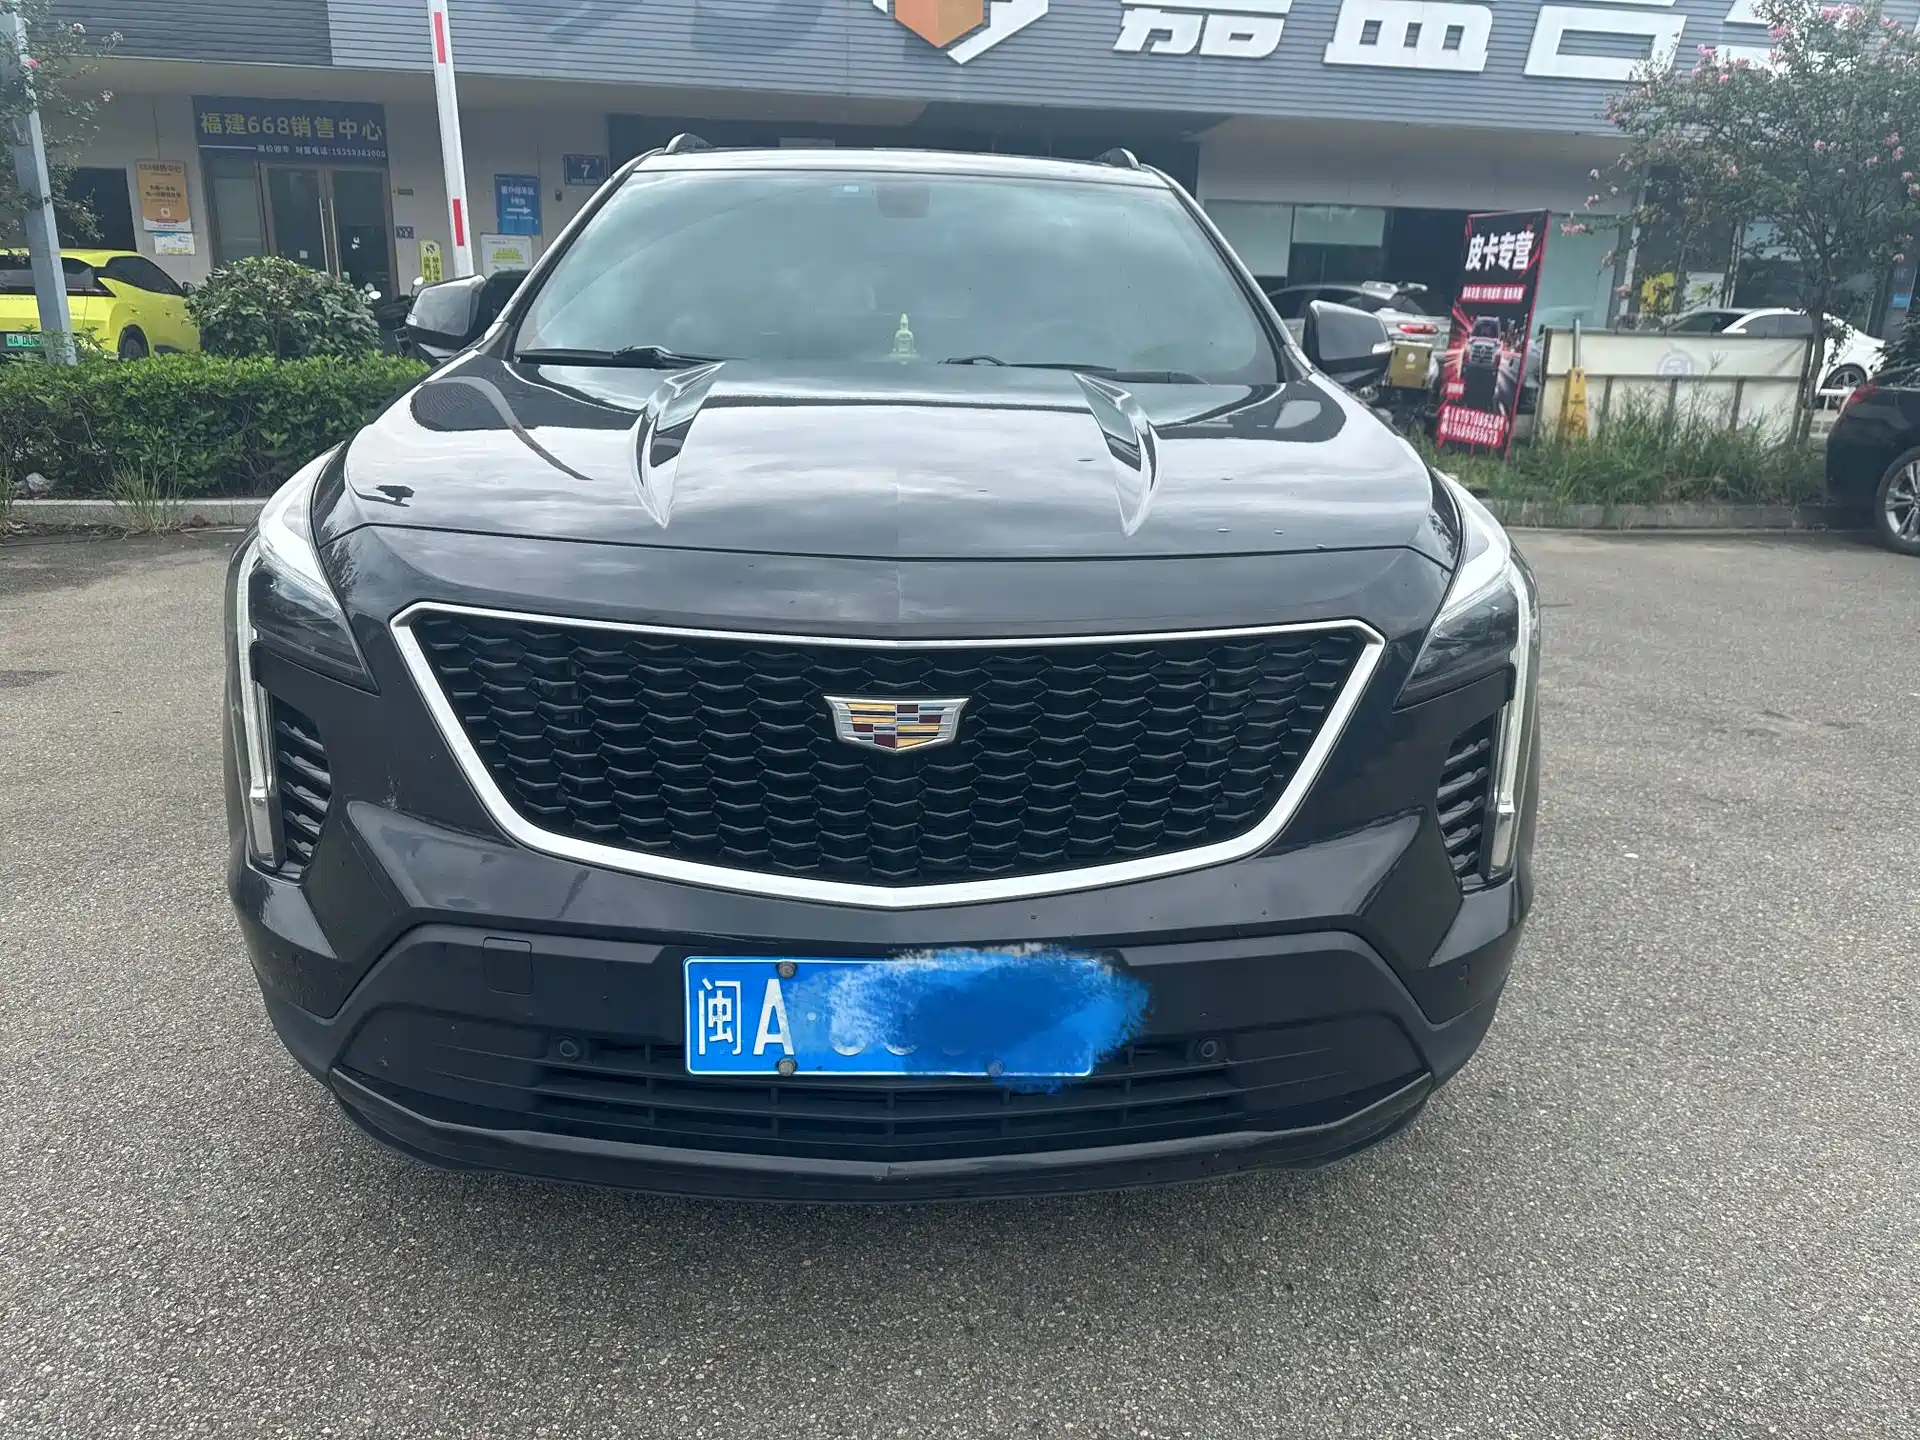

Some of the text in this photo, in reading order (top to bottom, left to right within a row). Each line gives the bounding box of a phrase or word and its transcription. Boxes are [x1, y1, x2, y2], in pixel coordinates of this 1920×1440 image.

[200, 111, 383, 141] 福建668销售中心
[581, 163, 592, 179] 7
[1465, 230, 1535, 271] 皮卡专营
